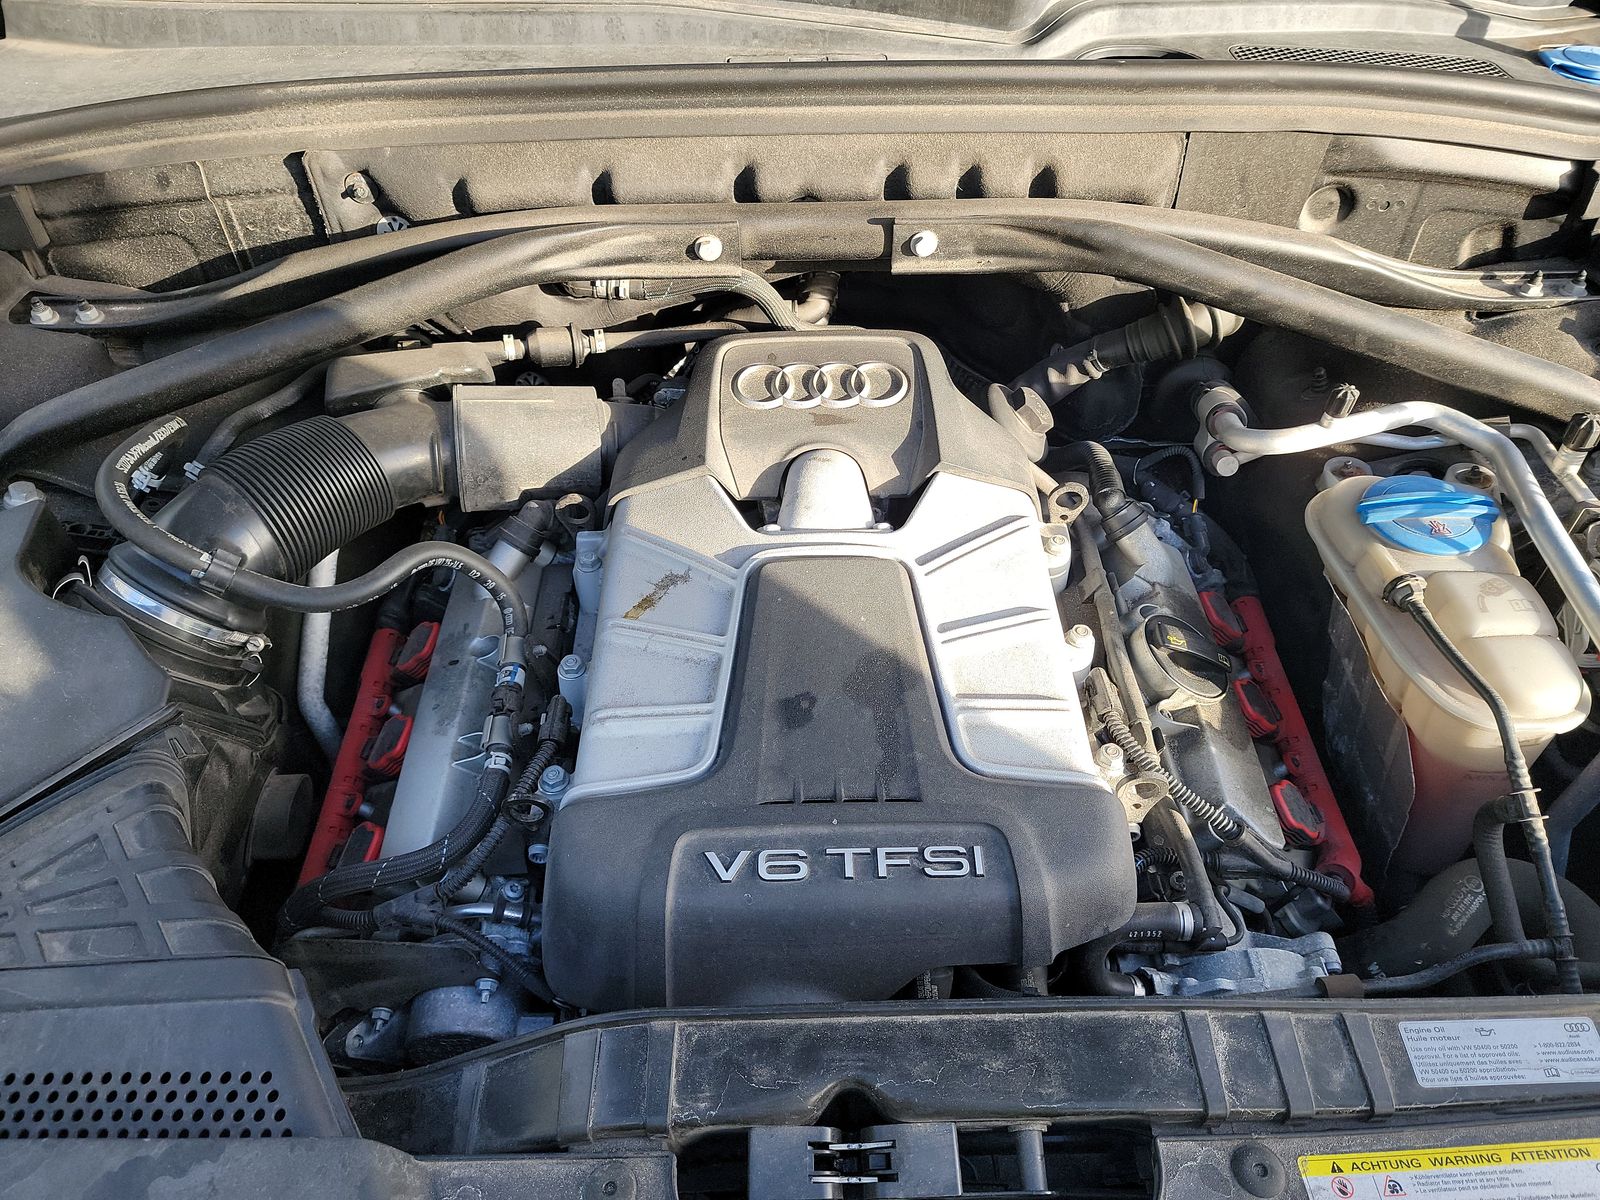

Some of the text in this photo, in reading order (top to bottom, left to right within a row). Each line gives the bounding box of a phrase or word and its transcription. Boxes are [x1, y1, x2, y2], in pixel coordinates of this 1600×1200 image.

[703, 845, 985, 883] V6 TFSI
[1404, 1026, 1432, 1034] Engine
[1351, 1147, 1591, 1172] ACHTUNG WARNING ATTENTION
